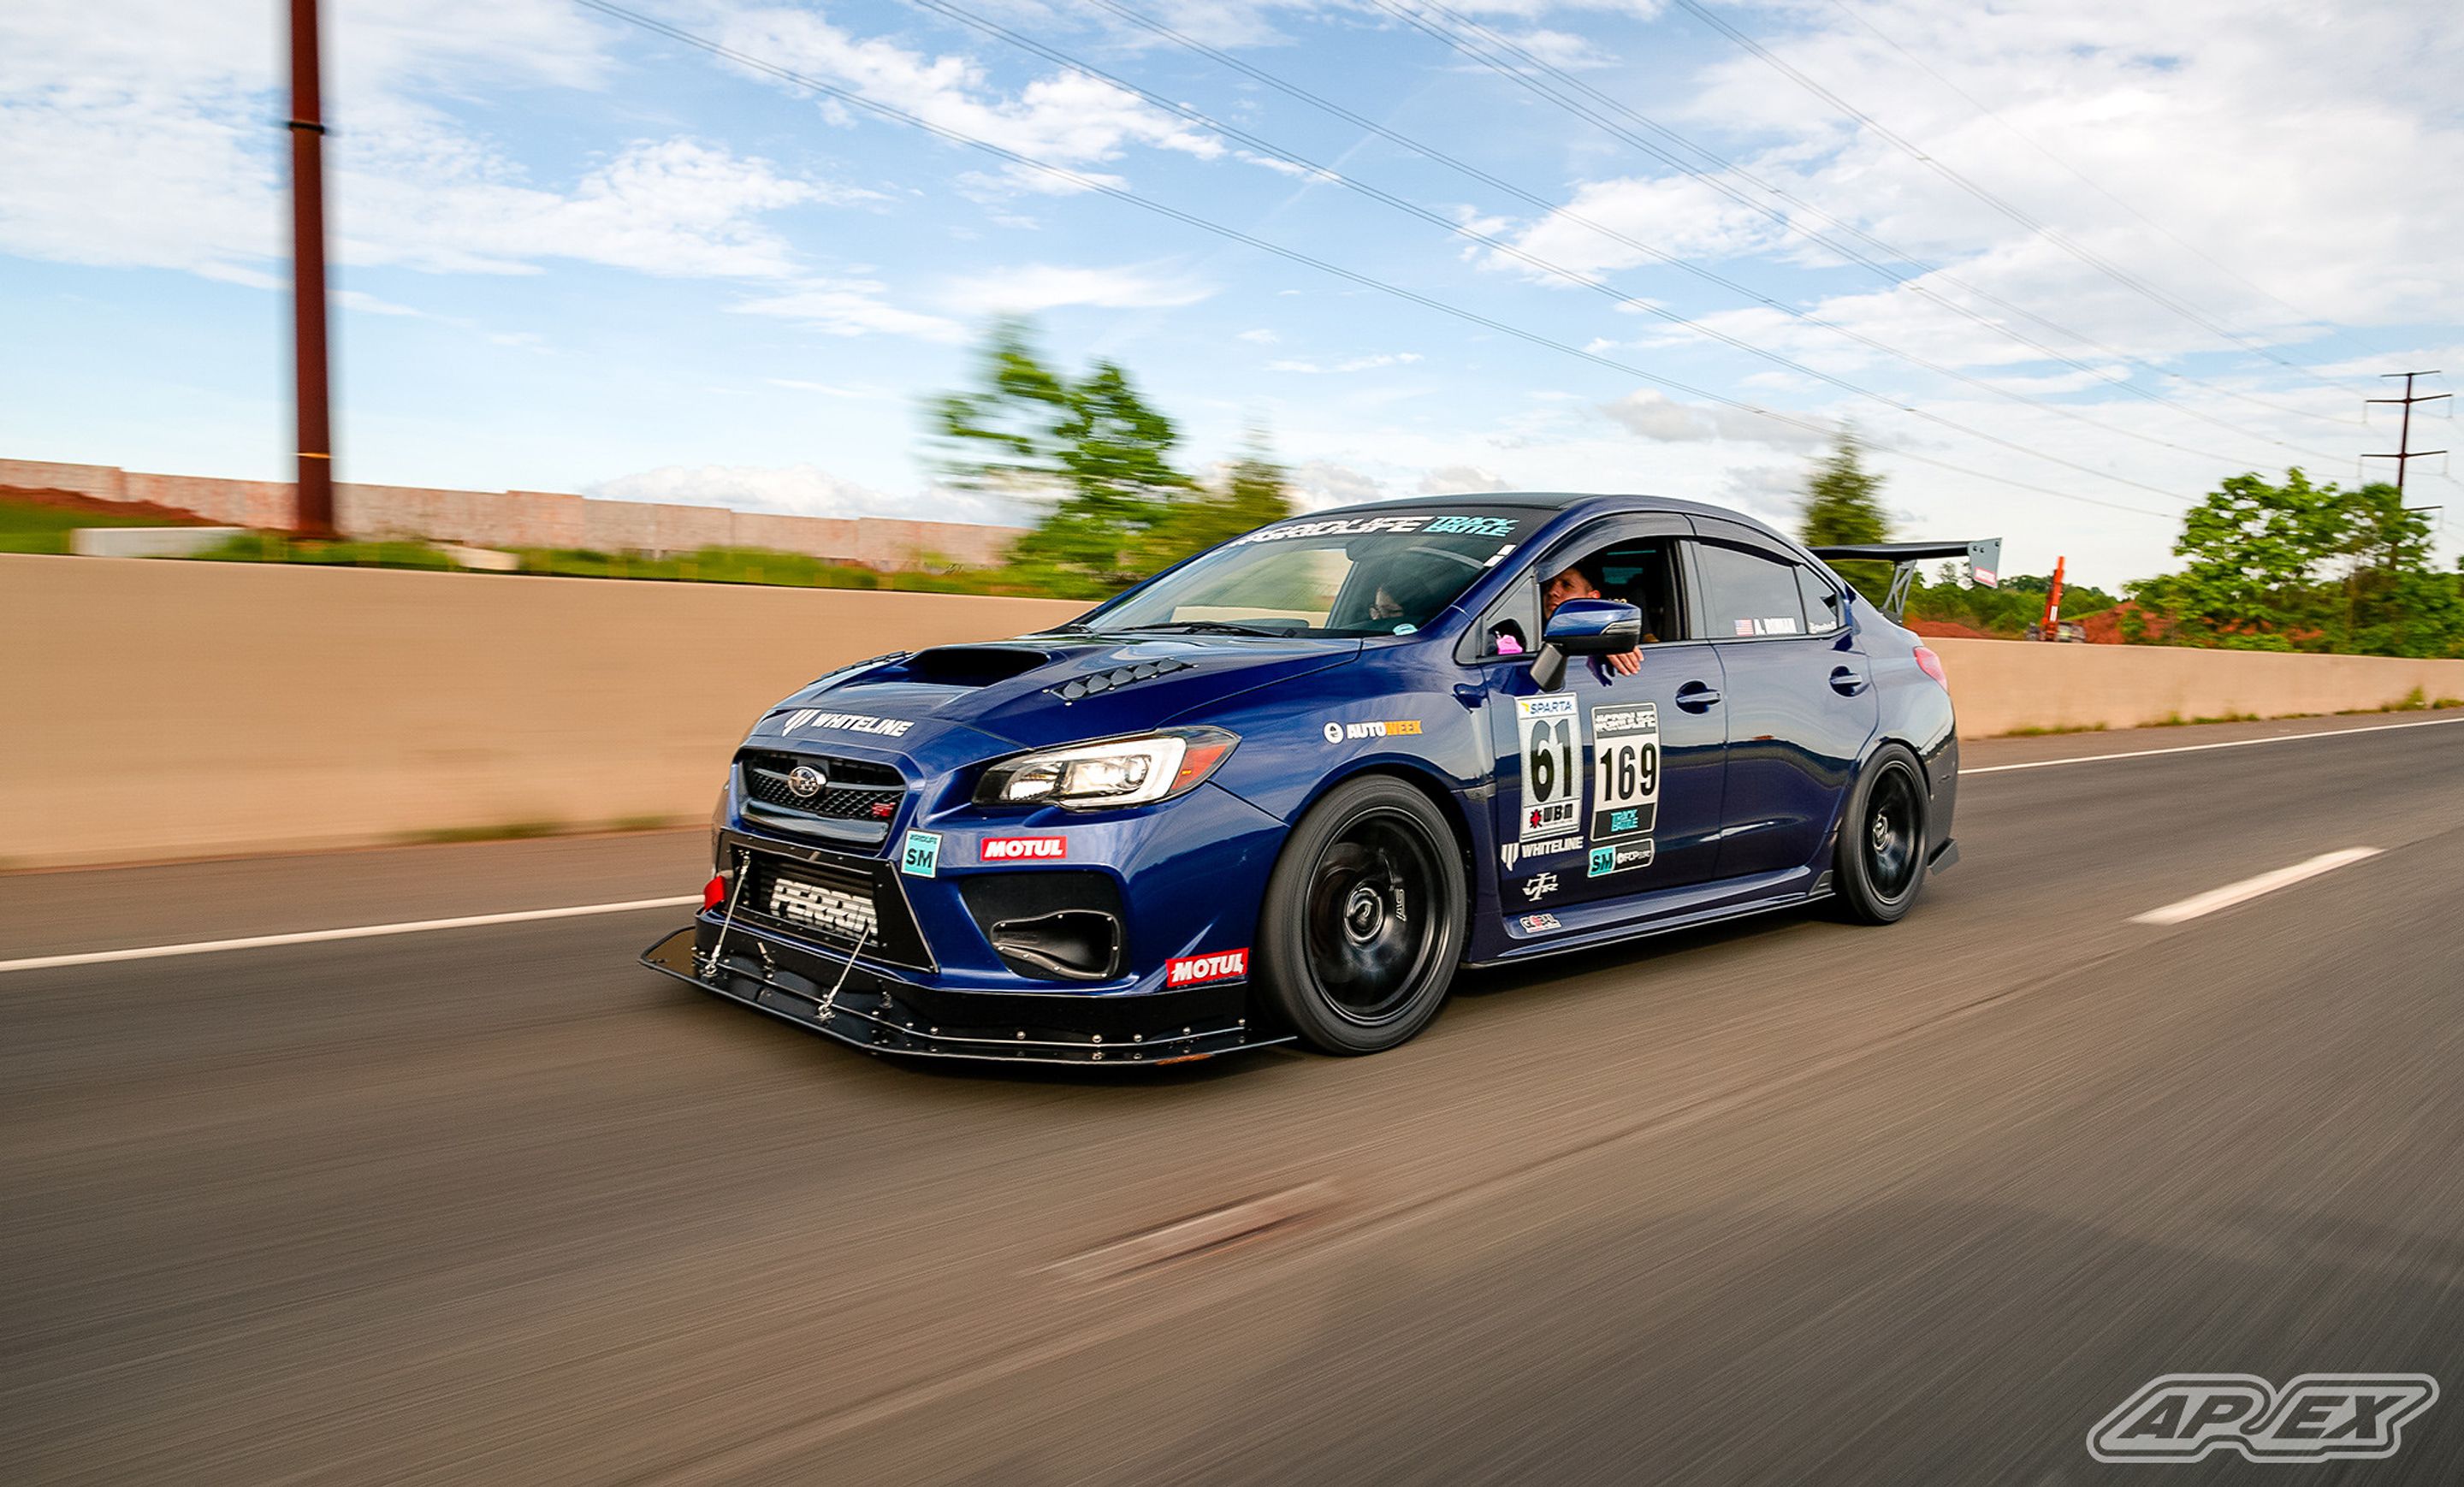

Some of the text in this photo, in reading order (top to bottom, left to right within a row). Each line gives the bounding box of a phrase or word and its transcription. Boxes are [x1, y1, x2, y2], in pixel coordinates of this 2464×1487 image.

[1530, 702, 1573, 714] SPARTA
[810, 713, 915, 738] WHITELINE
[1530, 720, 1572, 803] 61
[1600, 743, 1656, 802] 169
[906, 848, 933, 868] SM
[984, 839, 1063, 857] MOTUL
[1521, 836, 1584, 858] WHITELINE
[1591, 853, 1613, 872] SM
[1170, 953, 1244, 982] MOTUL
